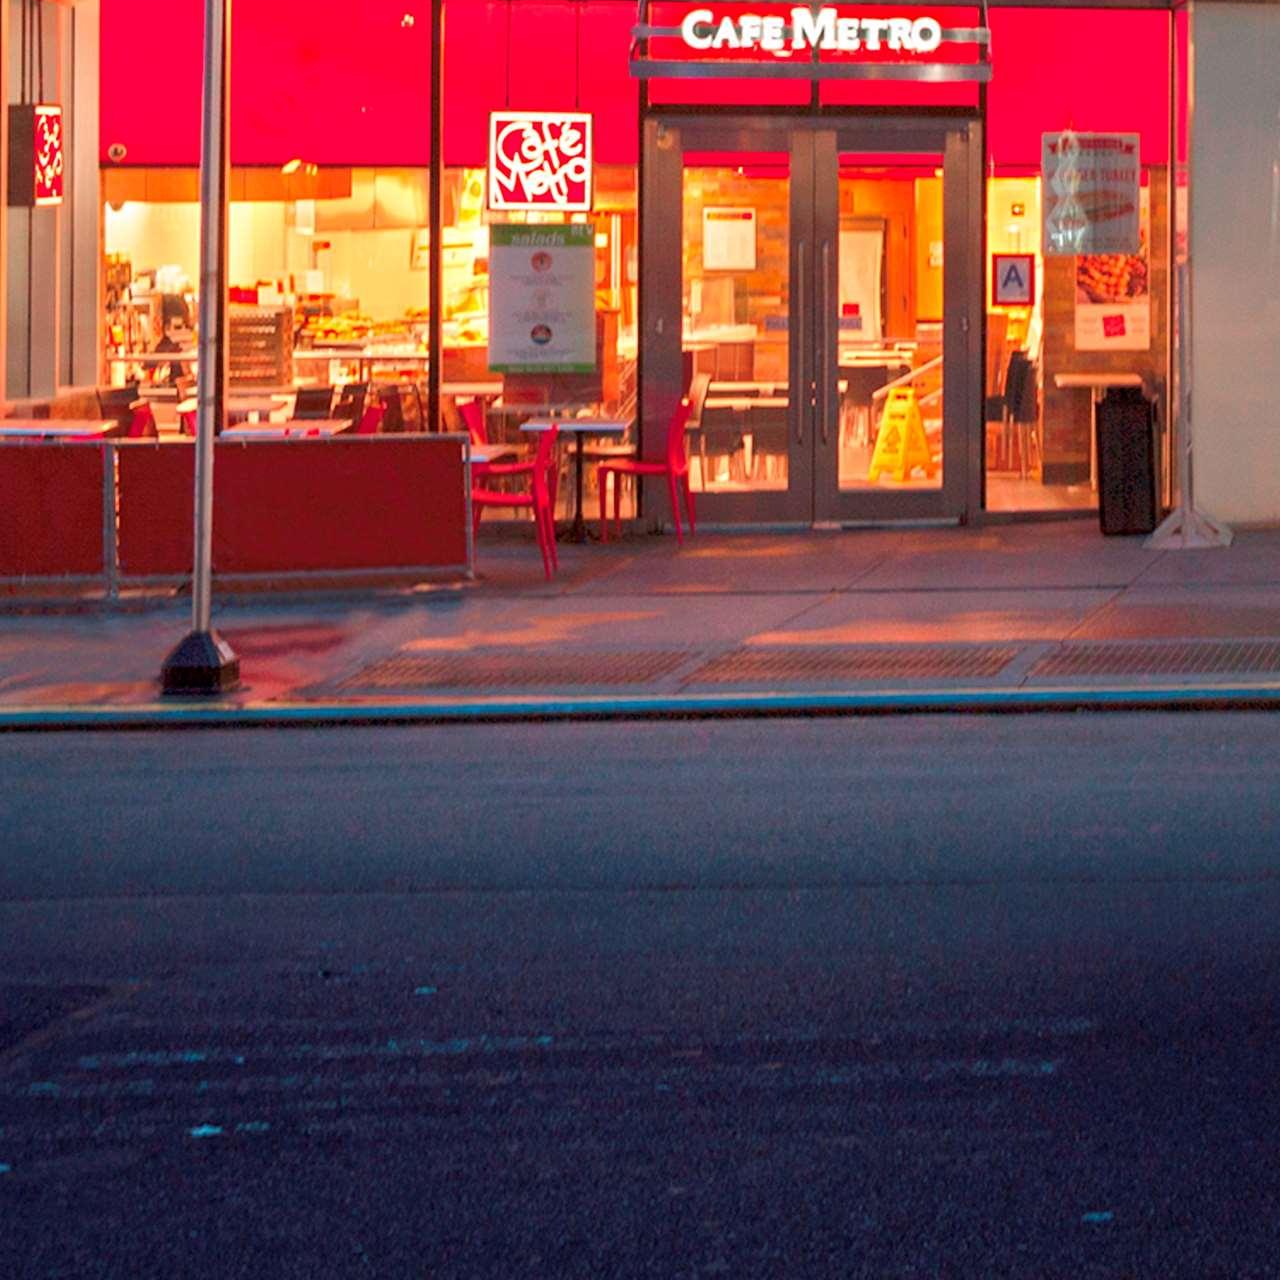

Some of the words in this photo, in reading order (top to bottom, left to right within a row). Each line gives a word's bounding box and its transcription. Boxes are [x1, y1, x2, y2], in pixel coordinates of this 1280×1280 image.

[681, 8, 785, 50] CAFE
[790, 6, 942, 53] METRO
[1002, 263, 1024, 289] A
